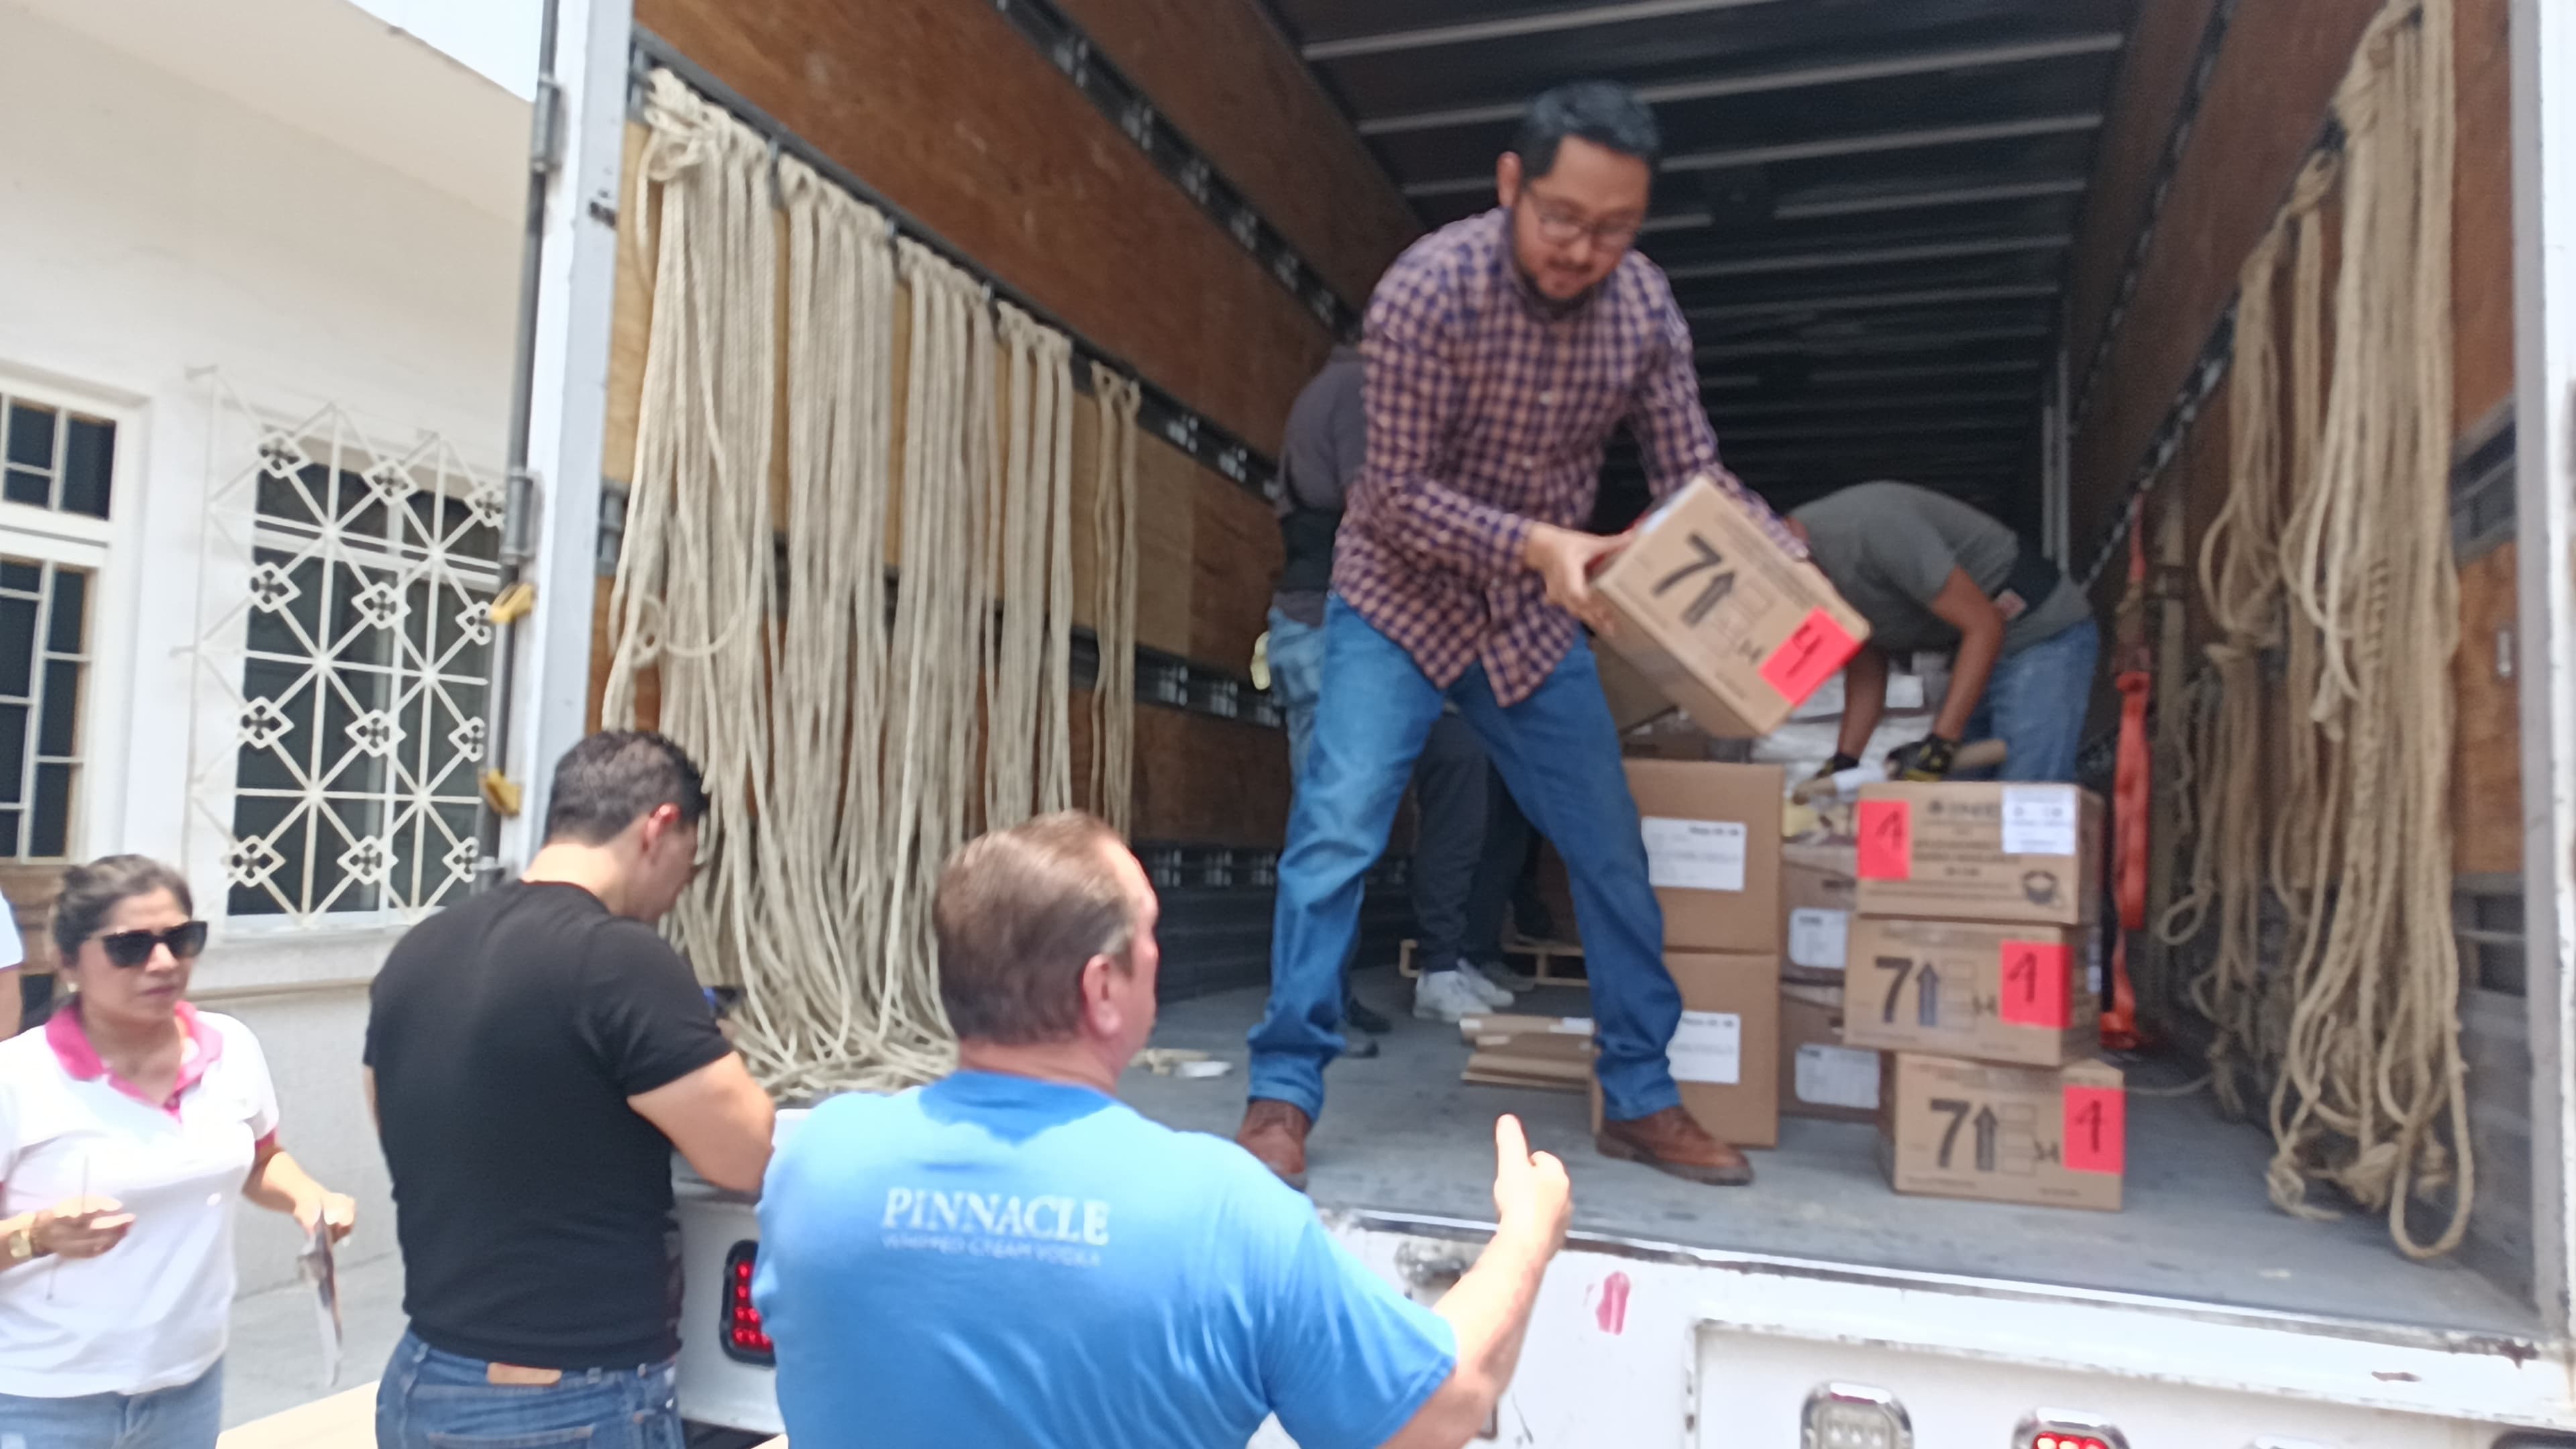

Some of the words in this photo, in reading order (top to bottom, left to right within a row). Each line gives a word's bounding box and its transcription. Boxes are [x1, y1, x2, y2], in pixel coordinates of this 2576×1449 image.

[1652, 532, 1723, 596] 7
[1874, 956, 1913, 1023] 7
[2007, 951, 2037, 1003] 1
[1929, 1098, 1970, 1169] 7
[2076, 1099, 2103, 1154] 1
[881, 1186, 1111, 1246] PINNACLE
